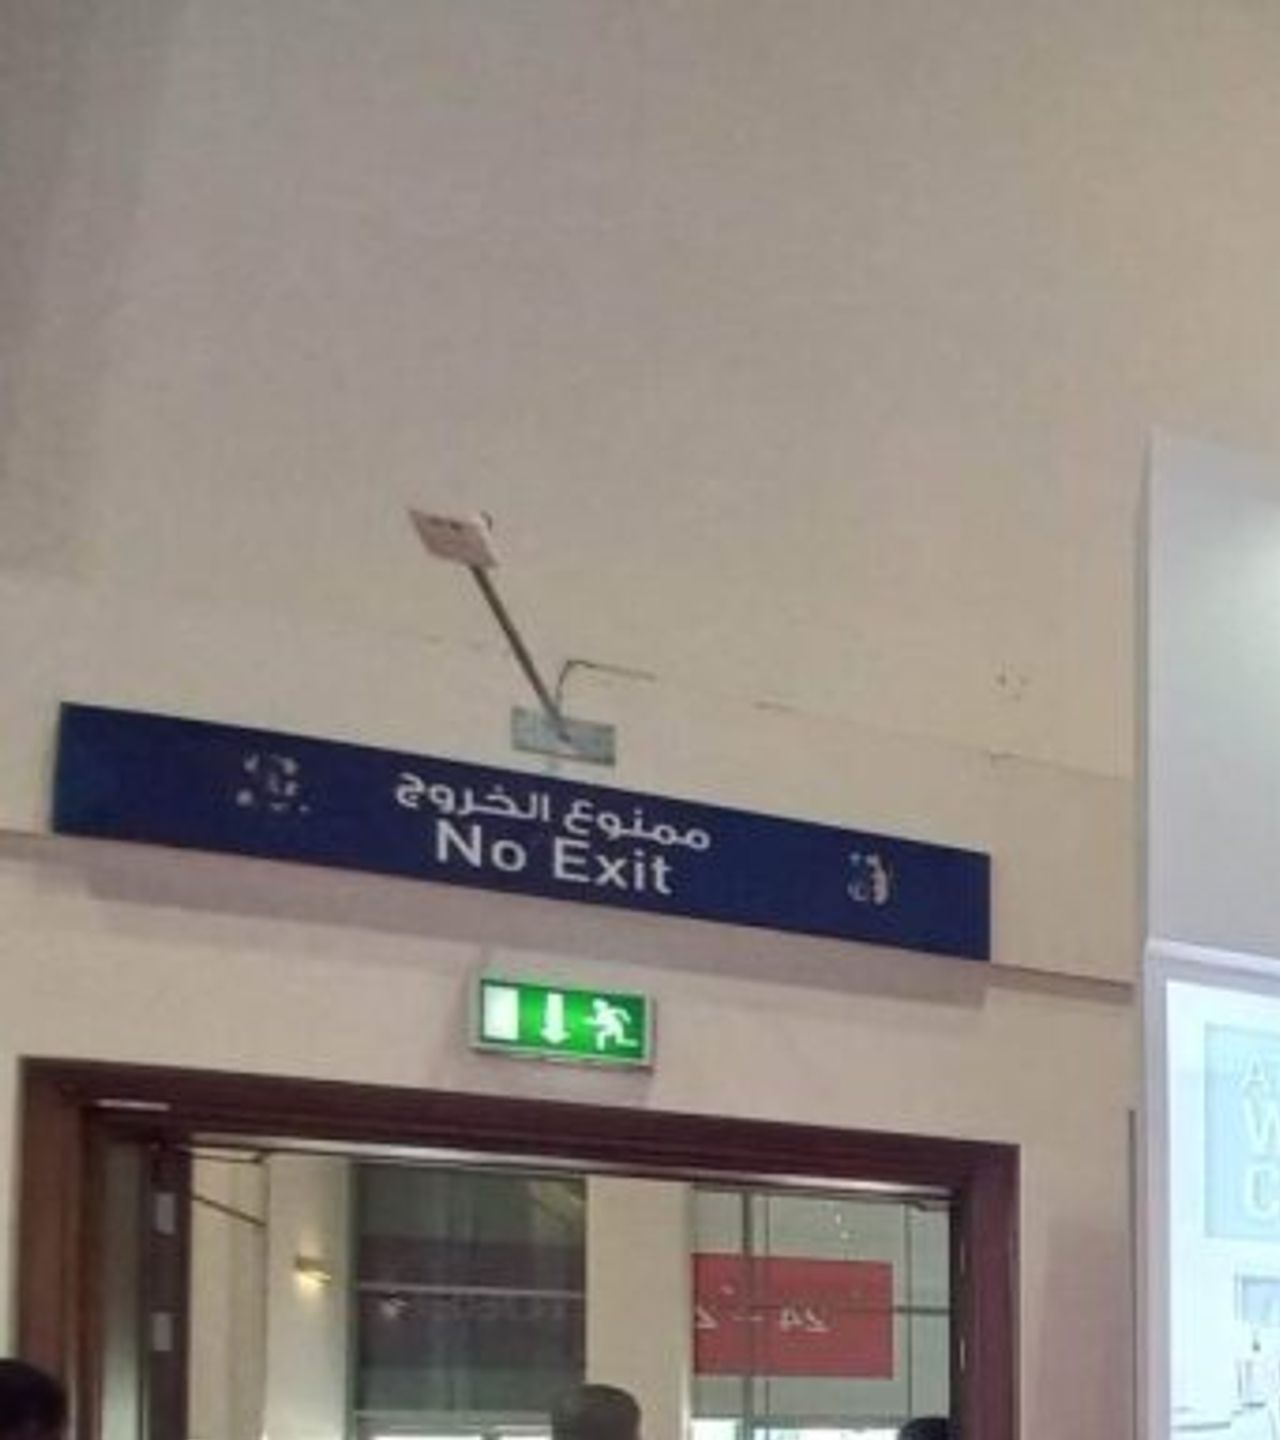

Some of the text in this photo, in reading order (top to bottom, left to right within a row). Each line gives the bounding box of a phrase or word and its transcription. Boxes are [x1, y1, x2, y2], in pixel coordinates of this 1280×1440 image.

[395, 771, 712, 850] ممنوع الخروج
[434, 817, 673, 896] No Exit
